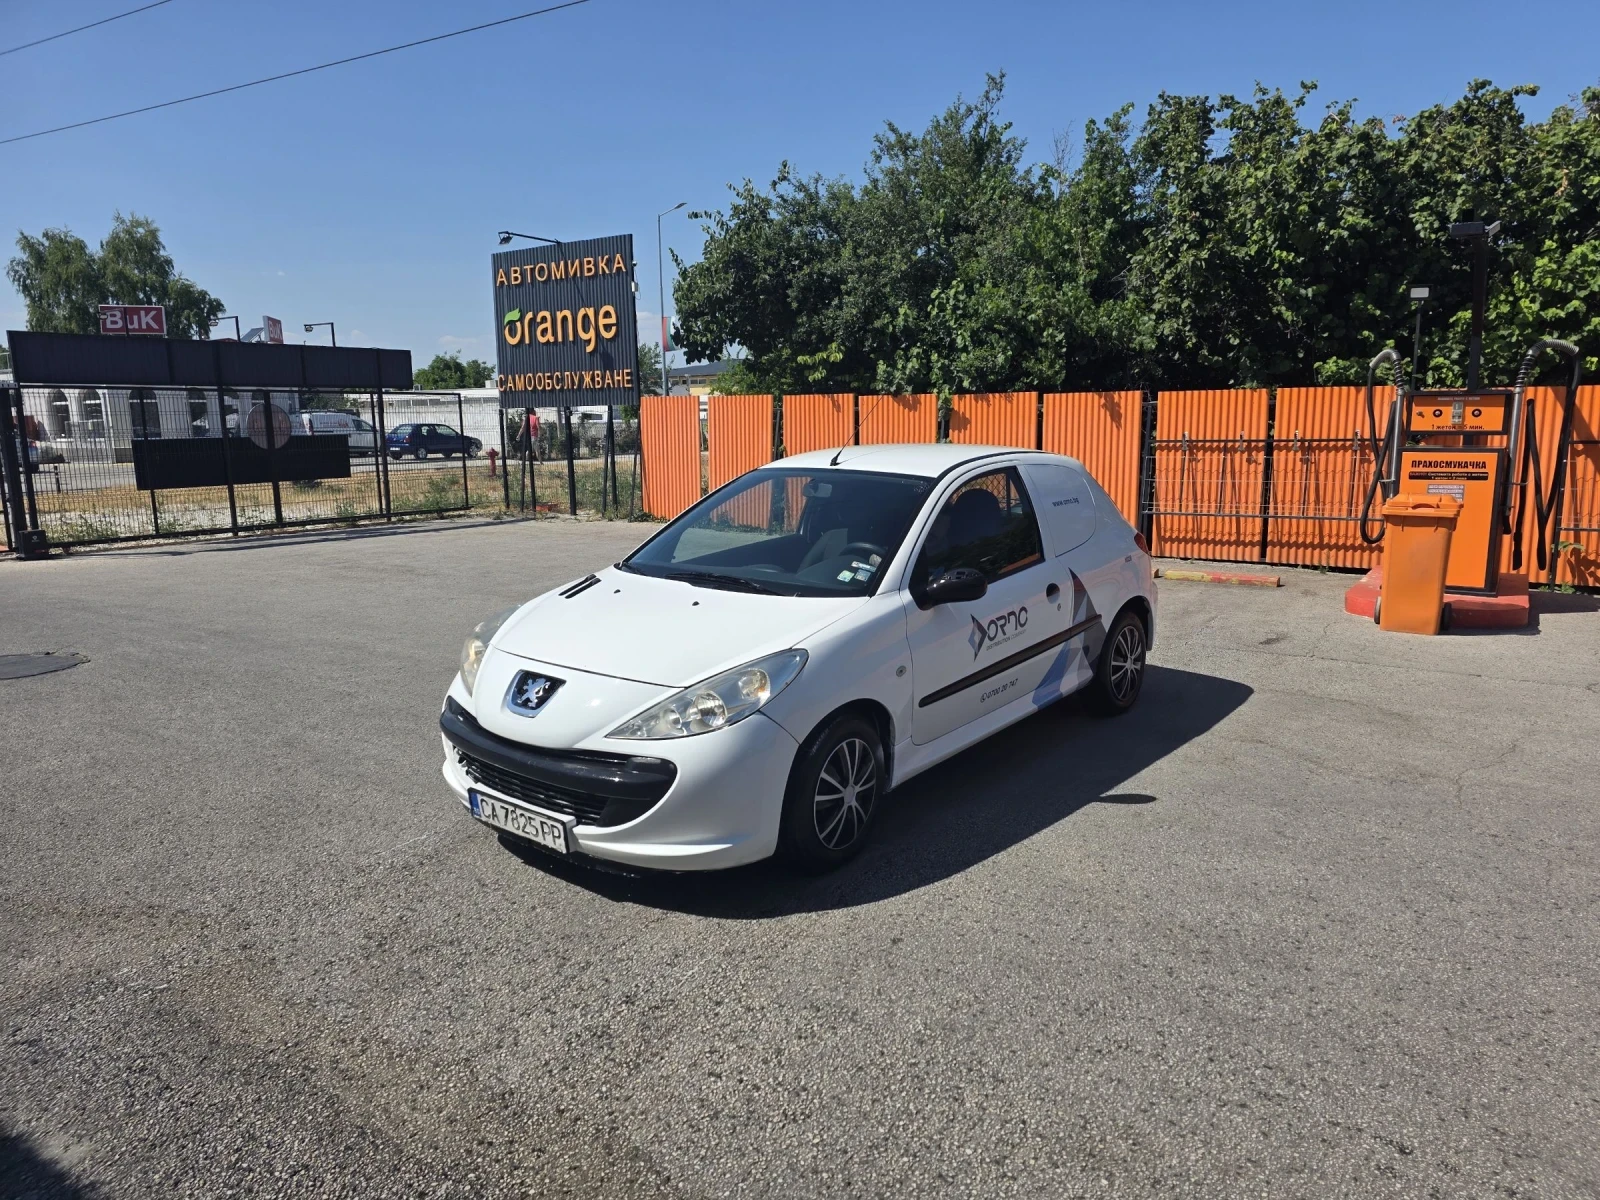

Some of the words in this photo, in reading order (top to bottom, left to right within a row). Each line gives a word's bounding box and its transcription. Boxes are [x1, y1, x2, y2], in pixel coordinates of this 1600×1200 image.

[496, 253, 627, 287] АВТОМИВКА
[504, 304, 618, 353] orange
[497, 368, 633, 392] САМООБСЛУЖВАНЕ
[1411, 460, 1487, 469] ПРАХОСМУКАЧКА
